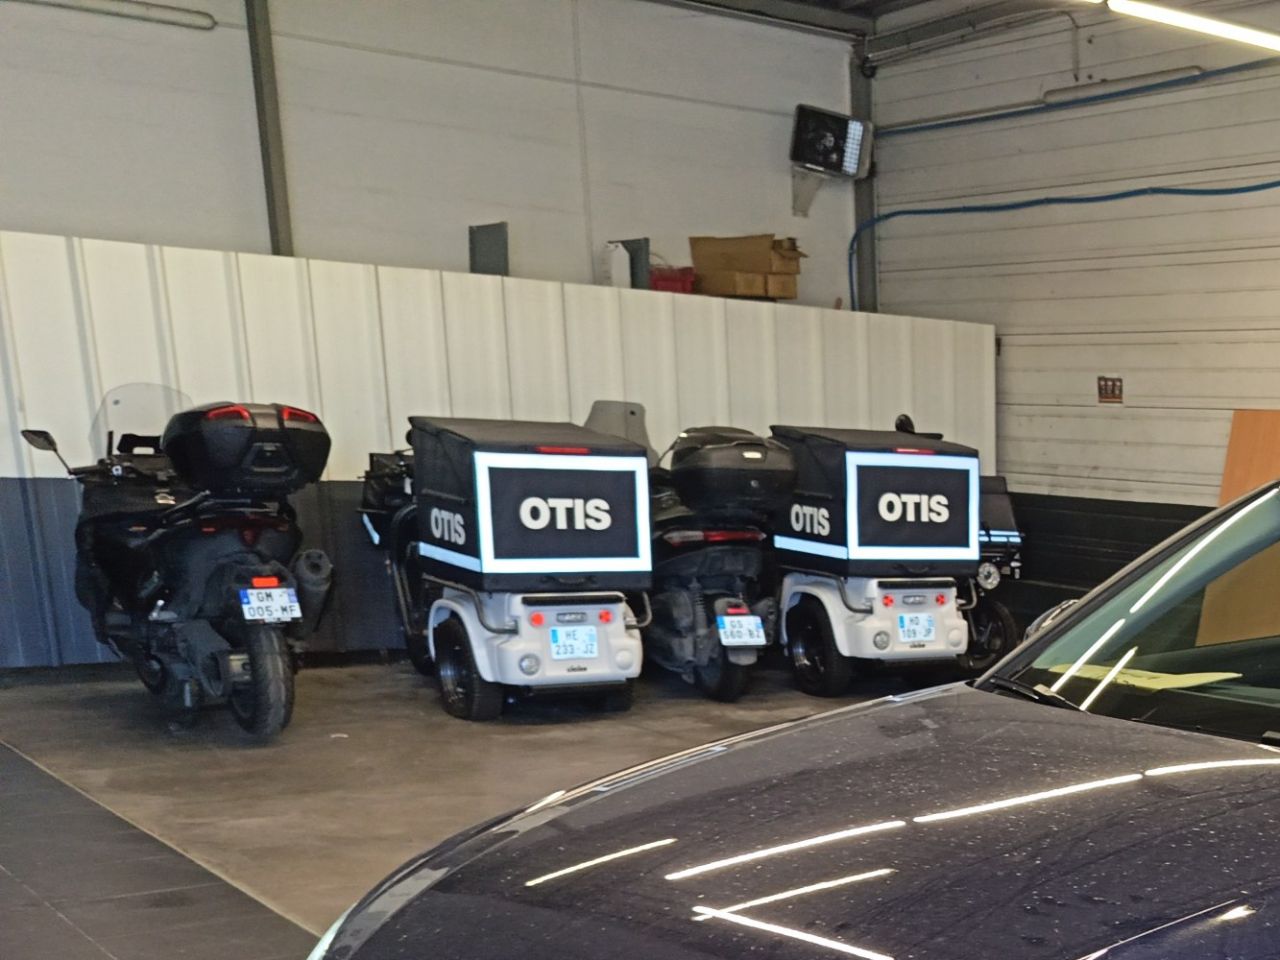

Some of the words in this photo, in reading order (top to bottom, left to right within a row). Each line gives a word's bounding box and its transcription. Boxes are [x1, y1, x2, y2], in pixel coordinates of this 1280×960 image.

[519, 496, 612, 531] OTIS
[790, 503, 831, 536] OTIS
[878, 492, 949, 523] OTIS
[430, 507, 466, 546] OTIS
